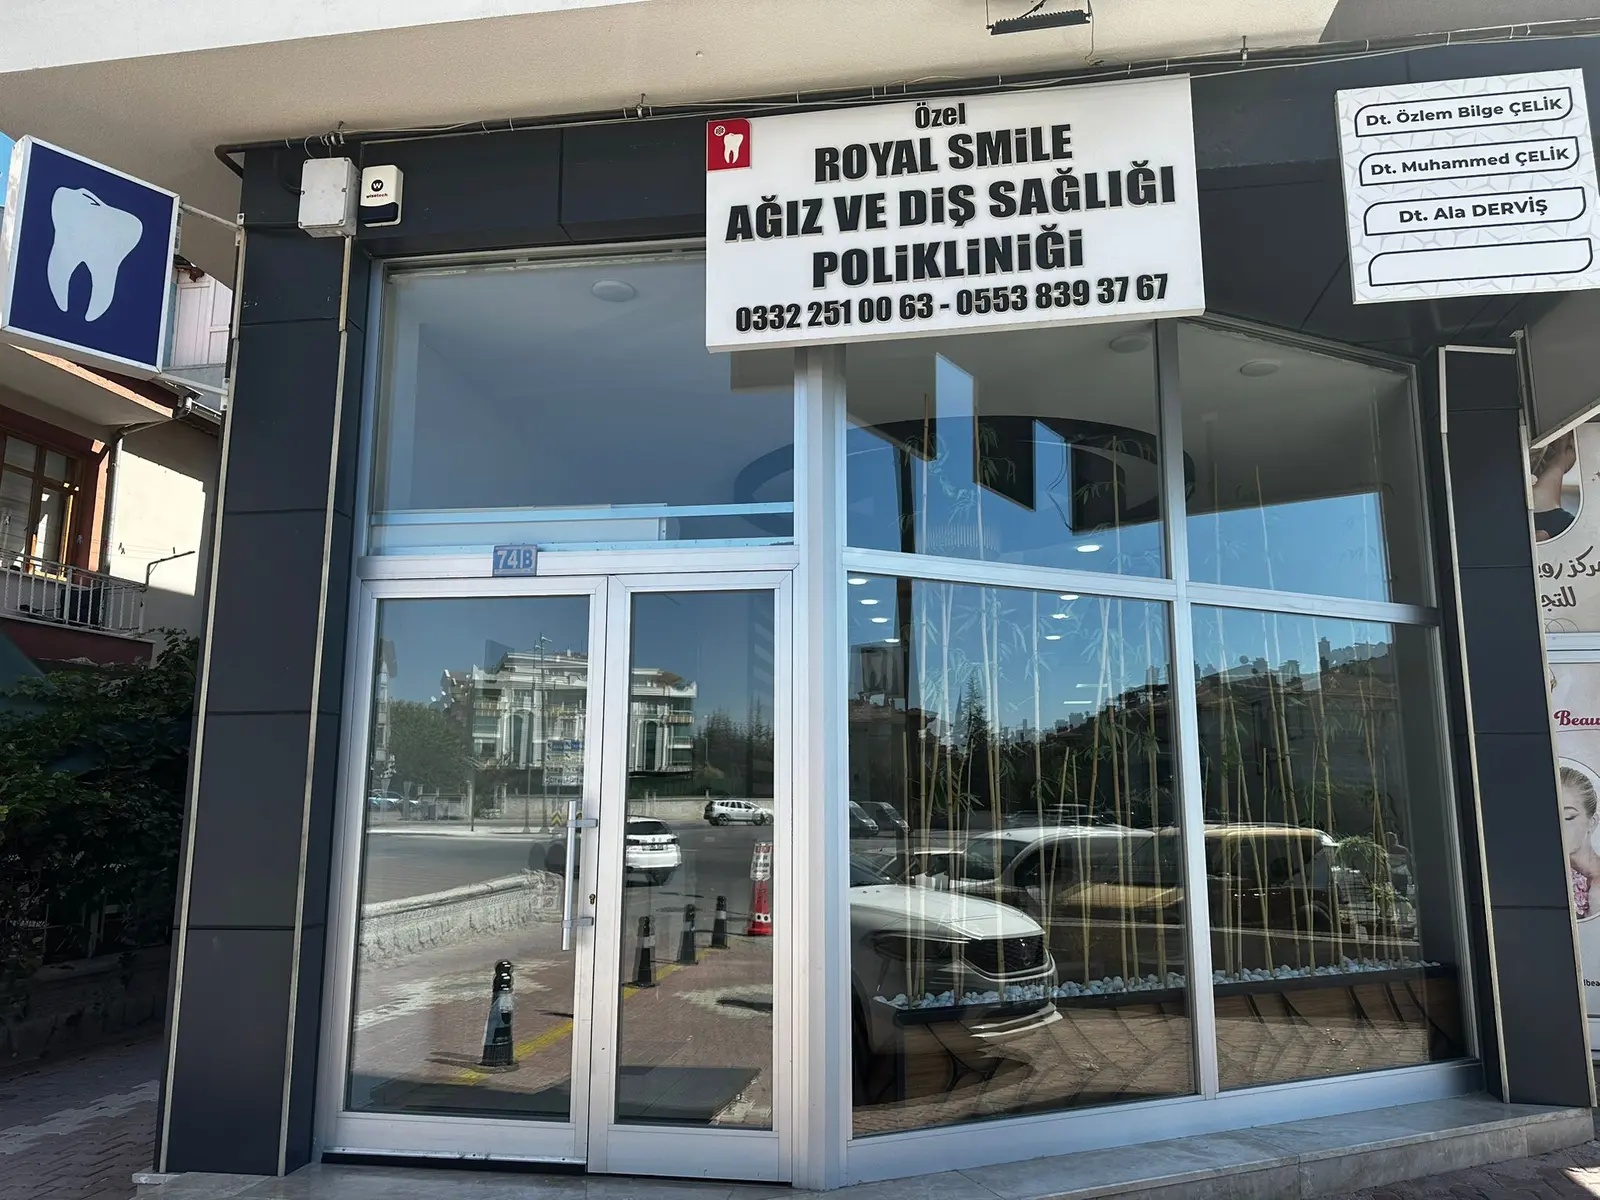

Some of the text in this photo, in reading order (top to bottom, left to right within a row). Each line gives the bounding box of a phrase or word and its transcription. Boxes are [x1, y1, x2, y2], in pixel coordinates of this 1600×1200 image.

[913, 101, 967, 130] Özel
[1366, 96, 1562, 127] Dt. Özlem Bilge ÇELİK
[814, 137, 939, 183] ROYAL
[1370, 145, 1570, 176] Dt. Muhammed ÇELİK
[725, 194, 824, 243] AĞIZ
[832, 192, 887, 233] VE
[988, 159, 1176, 218] SAĞLIĞI
[1399, 196, 1548, 224] Dt. Ala DERVİŞ
[735, 303, 802, 332] 0332
[807, 299, 852, 327] 251
[858, 296, 892, 324] 00
[899, 292, 934, 320] 63
[956, 284, 1028, 316] 0553
[1035, 279, 1090, 309] 839
[1096, 275, 1129, 304] 37
[1136, 272, 1168, 301] 67
[497, 549, 536, 569] 74B
